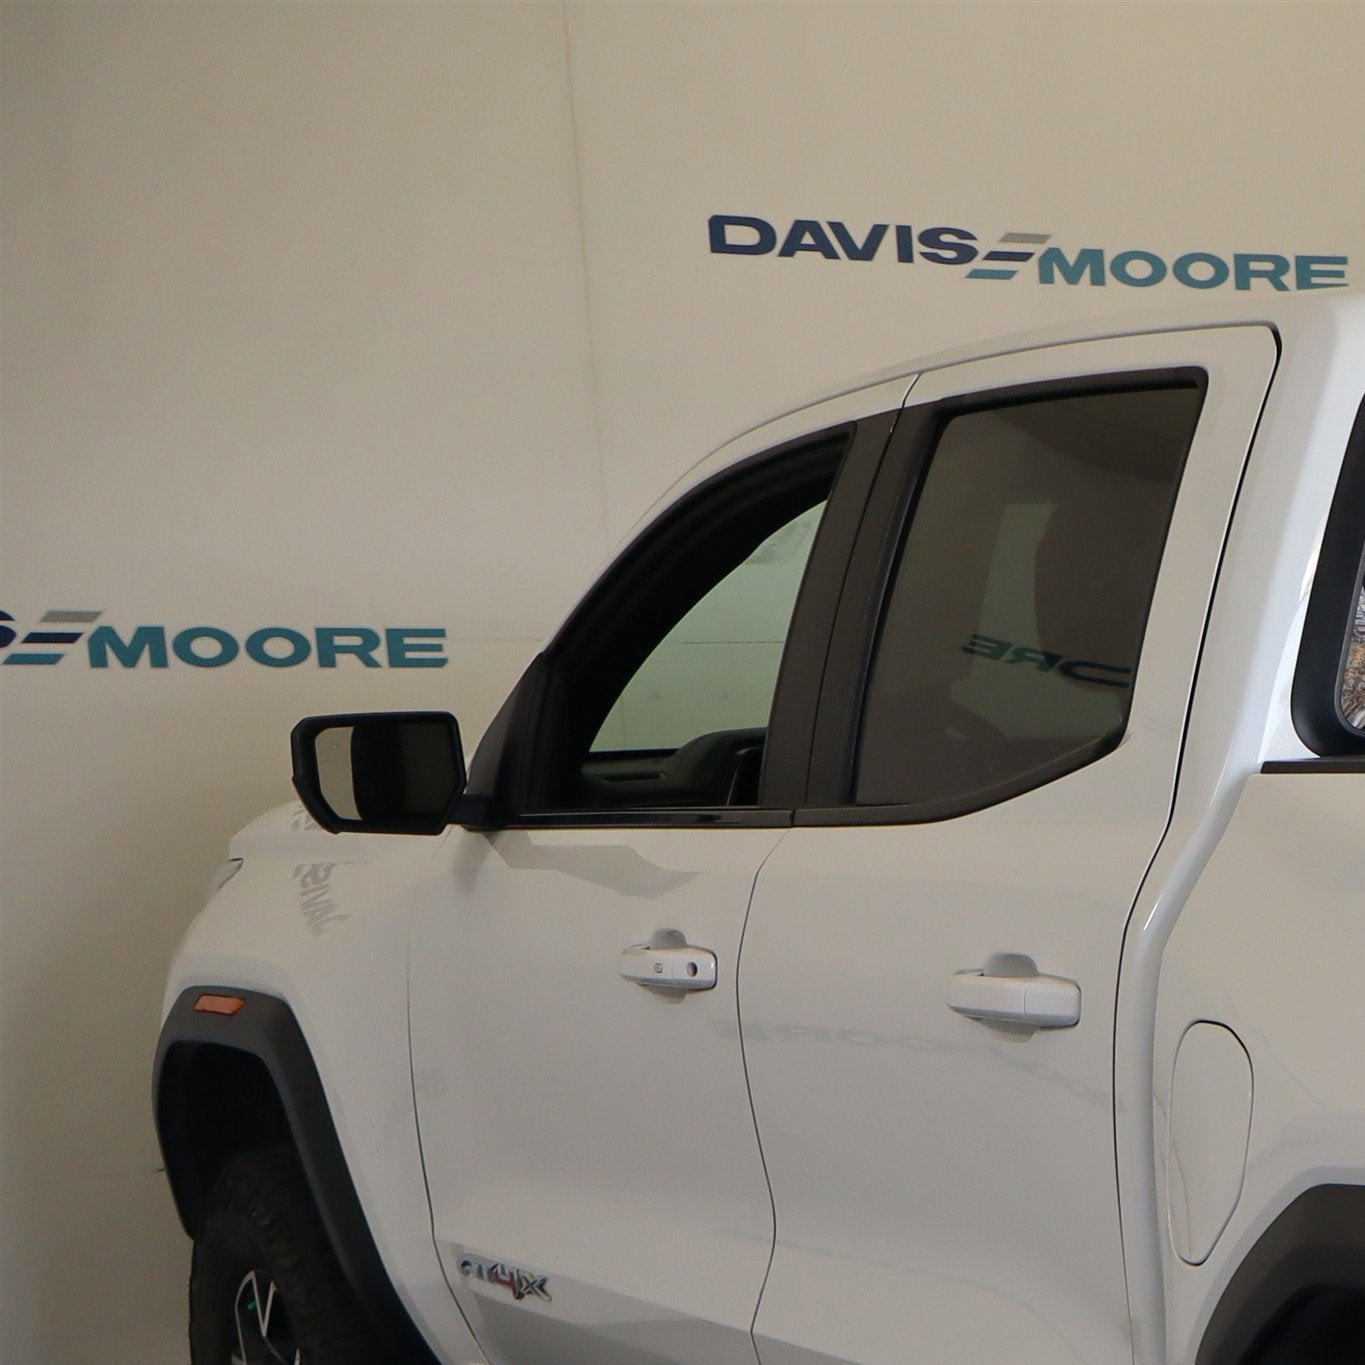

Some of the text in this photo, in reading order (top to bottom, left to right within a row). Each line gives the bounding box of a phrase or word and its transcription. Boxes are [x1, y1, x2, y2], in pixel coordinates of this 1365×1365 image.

[708, 214, 1349, 292] DAVIS MOORE
[87, 625, 449, 669] MOORE
